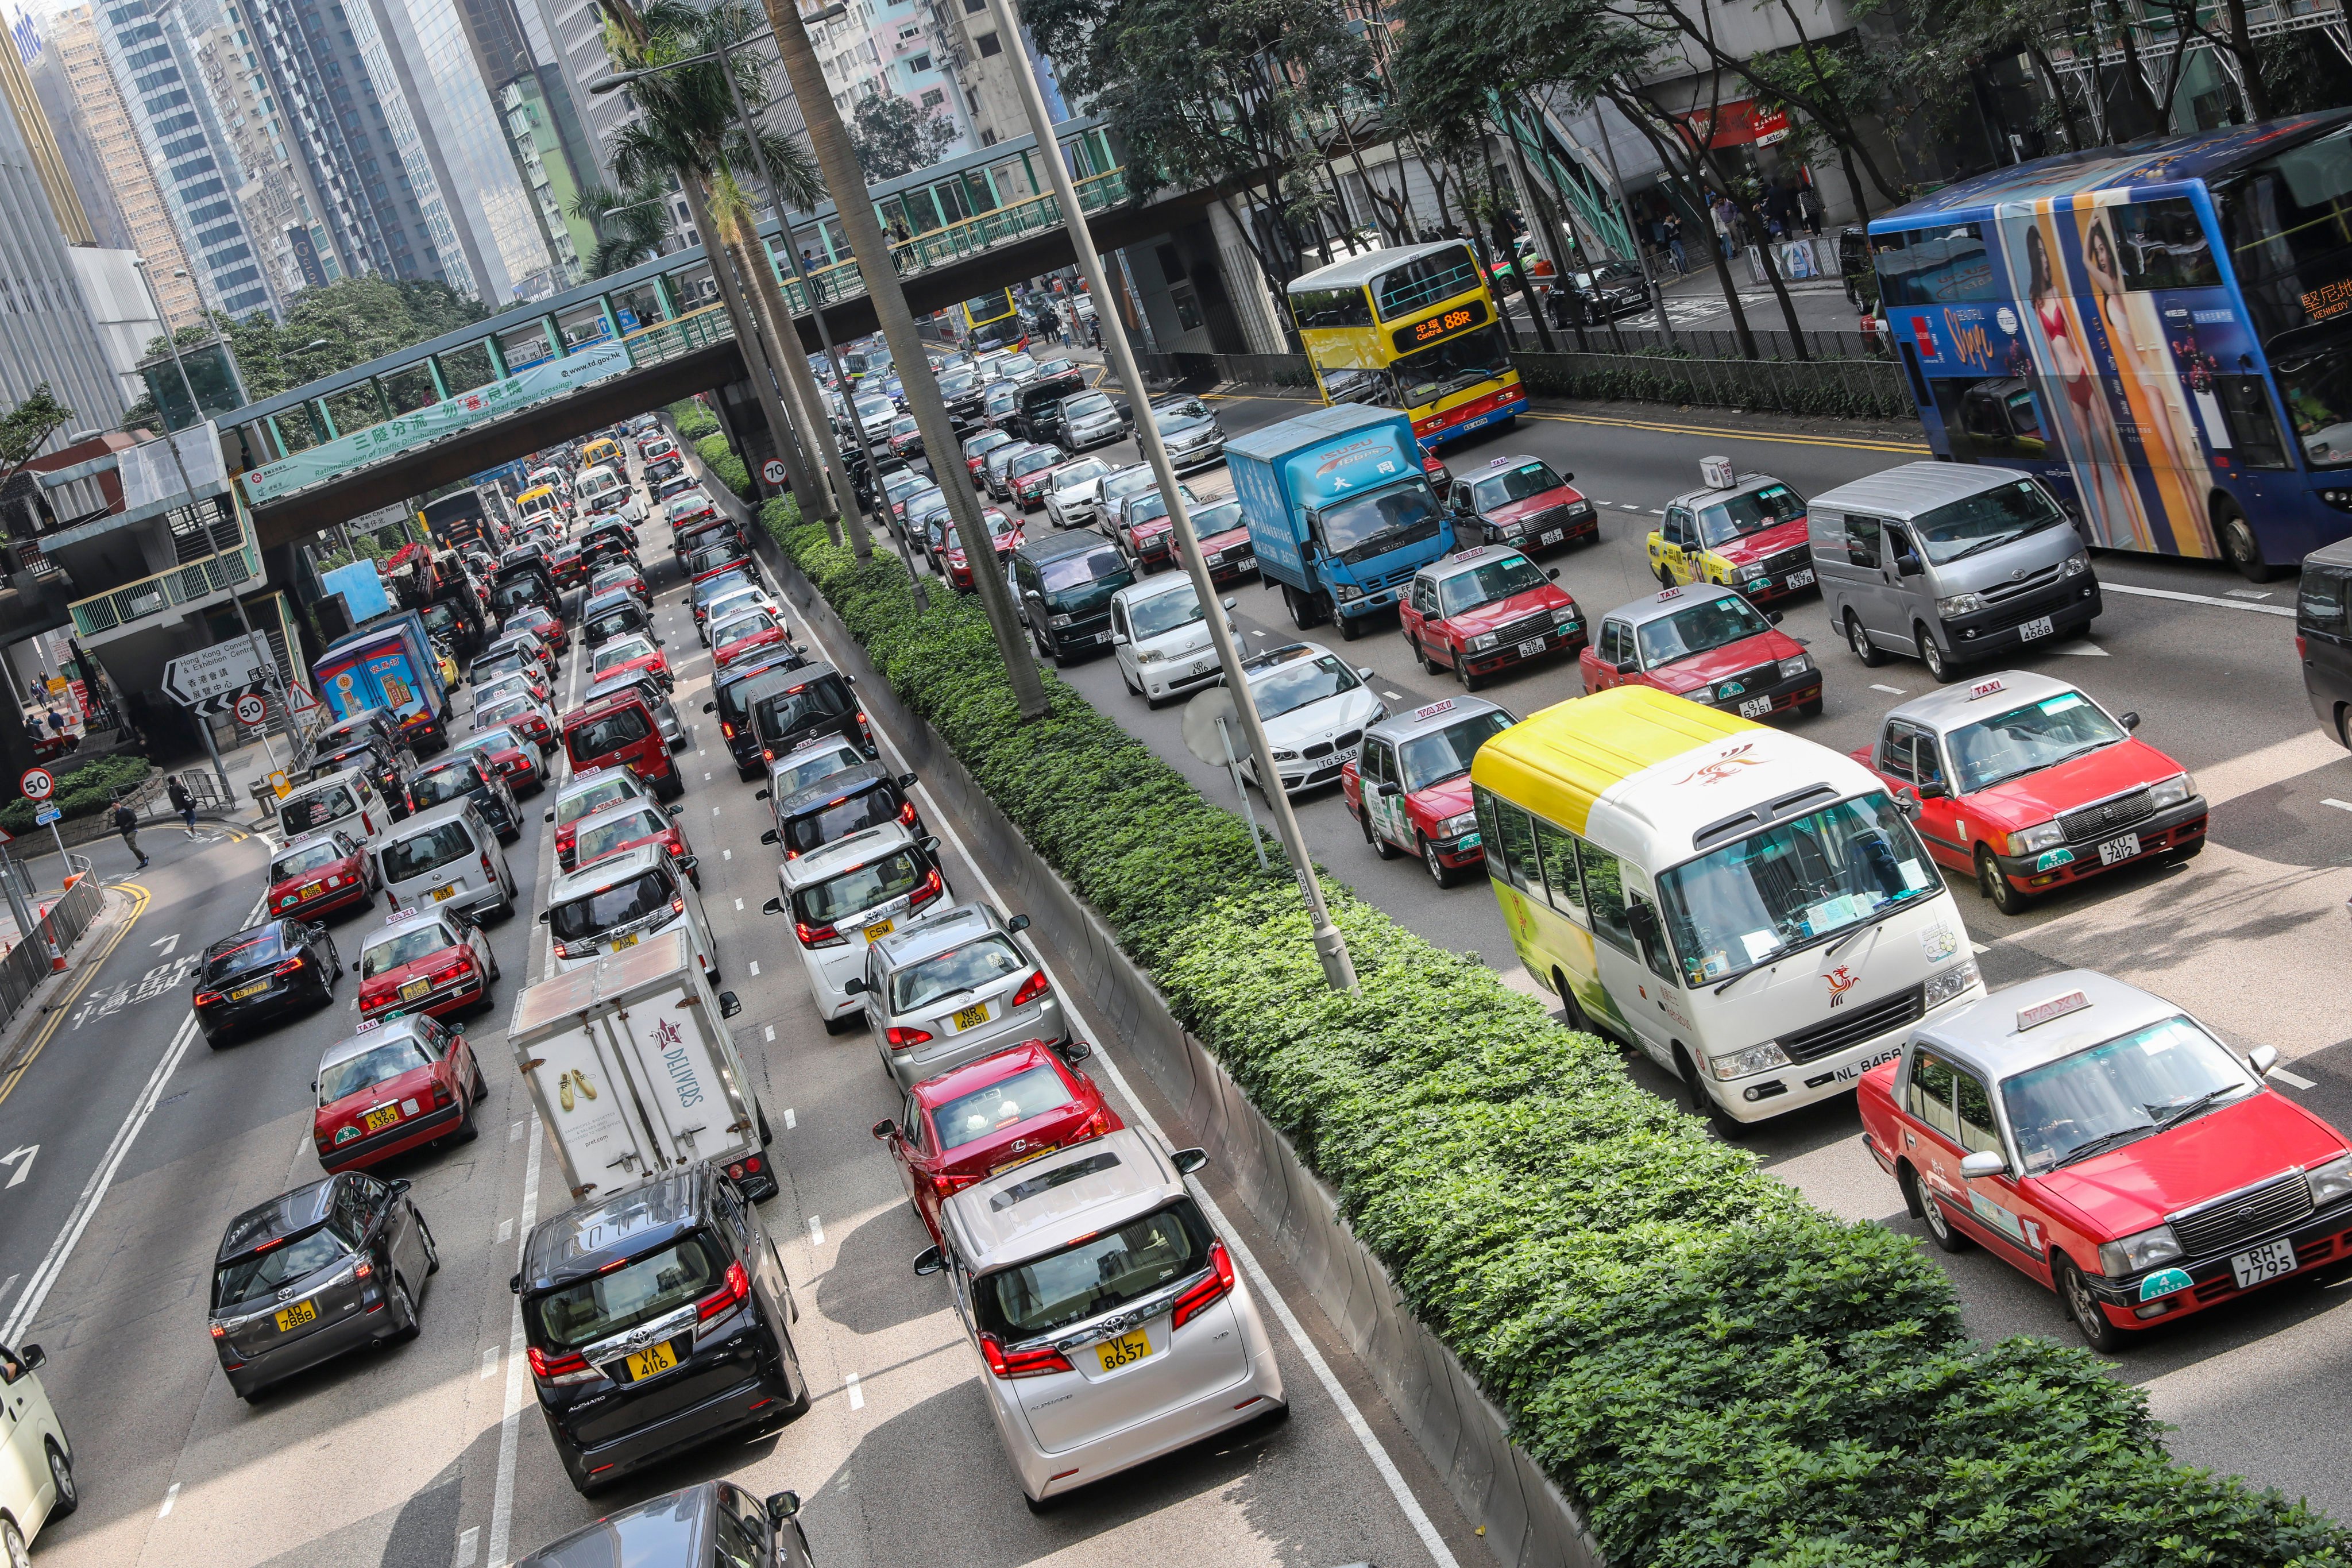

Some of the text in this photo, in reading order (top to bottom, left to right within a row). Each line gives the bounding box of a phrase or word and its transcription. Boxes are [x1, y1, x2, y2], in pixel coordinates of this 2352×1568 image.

[1409, 253, 1420, 261] 893
[2313, 300, 2349, 320] KENNEDY
[1415, 318, 1439, 334] 中環
[1444, 310, 1472, 330] 88R
[1416, 326, 1444, 341] Central
[523, 343, 537, 352] Road
[569, 350, 621, 376] www.td.gov.hk
[315, 453, 368, 477] Rationalisation
[369, 449, 377, 458] of
[377, 440, 400, 454] Traffic
[402, 426, 443, 448] Distribution
[444, 417, 469, 432] among
[470, 410, 490, 422] Three
[491, 403, 509, 415] Road
[511, 394, 539, 410] Harbour
[540, 380, 573, 399] Crossings
[1473, 418, 1487, 427] 4408
[353, 413, 428, 451] 三隧分流
[1320, 438, 1373, 461] ISUZU
[1492, 457, 1507, 466] TAXI
[765, 464, 785, 479] 70
[1724, 468, 1732, 481] 的士
[358, 503, 402, 522] Wan Chai North
[1543, 534, 1562, 545] 2087
[1547, 530, 1556, 538] JX
[1380, 540, 1405, 553] ISUZU
[1456, 546, 1484, 561] TAXI
[378, 560, 387, 569] 70
[1790, 576, 1813, 589] 6378
[1793, 571, 1806, 581] MG
[1401, 584, 1411, 592] FF
[1659, 587, 1680, 599] TAXI
[2023, 625, 2050, 639] 4668
[2026, 619, 2042, 631] LJ
[1521, 643, 1544, 657] 9468
[1525, 639, 1537, 649] SN
[180, 648, 221, 667] Hong Kong
[183, 645, 254, 675] & Exhibition Centre
[1193, 661, 1203, 669] UD
[187, 667, 229, 688] 香港會議
[1192, 665, 1208, 675] 4316
[192, 679, 233, 700] 展覽中心
[1723, 689, 1741, 698] SEATS
[1975, 679, 2002, 695] TAXI
[239, 701, 261, 718] 50
[1418, 700, 1453, 718] TAXI
[1744, 703, 1770, 718] 6761
[1747, 698, 1761, 709] GT
[798, 739, 813, 748] TAXI
[1319, 748, 1358, 769] TG 5638
[576, 767, 599, 779] TAXI
[25, 775, 49, 794] 50
[597, 797, 622, 810] TAXI
[295, 833, 310, 842] TAXI
[2109, 836, 2126, 849] KU
[2050, 854, 2058, 862] 5
[2106, 845, 2134, 863] 7412
[2044, 858, 2067, 868] SEATS
[437, 890, 454, 901] 4681
[1297, 871, 1313, 905] 33342
[389, 908, 414, 922] TAXI
[1313, 913, 1321, 924] A
[869, 924, 890, 939] CSM
[619, 937, 631, 946] AD
[235, 982, 264, 999] AD 7777
[406, 988, 428, 999] 8805
[961, 1007, 977, 1019] NR
[2024, 991, 2084, 1022] TAXI
[960, 1012, 986, 1029] 4691
[1664, 1002, 1692, 1031] Rehabus
[357, 1020, 377, 1033] TAXI
[651, 1020, 682, 1049] PRET
[662, 1047, 704, 1109] DELIVERS
[1836, 1064, 1859, 1083] NL
[371, 1113, 396, 1130] 3369
[373, 1110, 388, 1120] LB
[590, 1111, 616, 1123] BAGUETTES
[565, 1136, 585, 1145] DELIVERED
[604, 1120, 621, 1130] OFFICE
[580, 1124, 595, 1134] SALADS
[340, 1134, 356, 1142] SEATS
[585, 1134, 609, 1148] pret.com
[717, 1152, 747, 1167] 2760 9933
[2248, 1244, 2276, 1266] RH
[2240, 1256, 2292, 1285] 7795
[2150, 1281, 2183, 1297] SEATS
[2159, 1276, 2170, 1287] 4
[287, 1305, 302, 1319] AD
[280, 1310, 313, 1330] 7888
[1109, 1335, 1133, 1352] VL
[639, 1348, 661, 1364] VA
[1104, 1342, 1144, 1370] 8657
[641, 1359, 669, 1376] 4116
[568, 1395, 607, 1412] ALPHARD
[1030, 1393, 1073, 1412] ALPHARD
